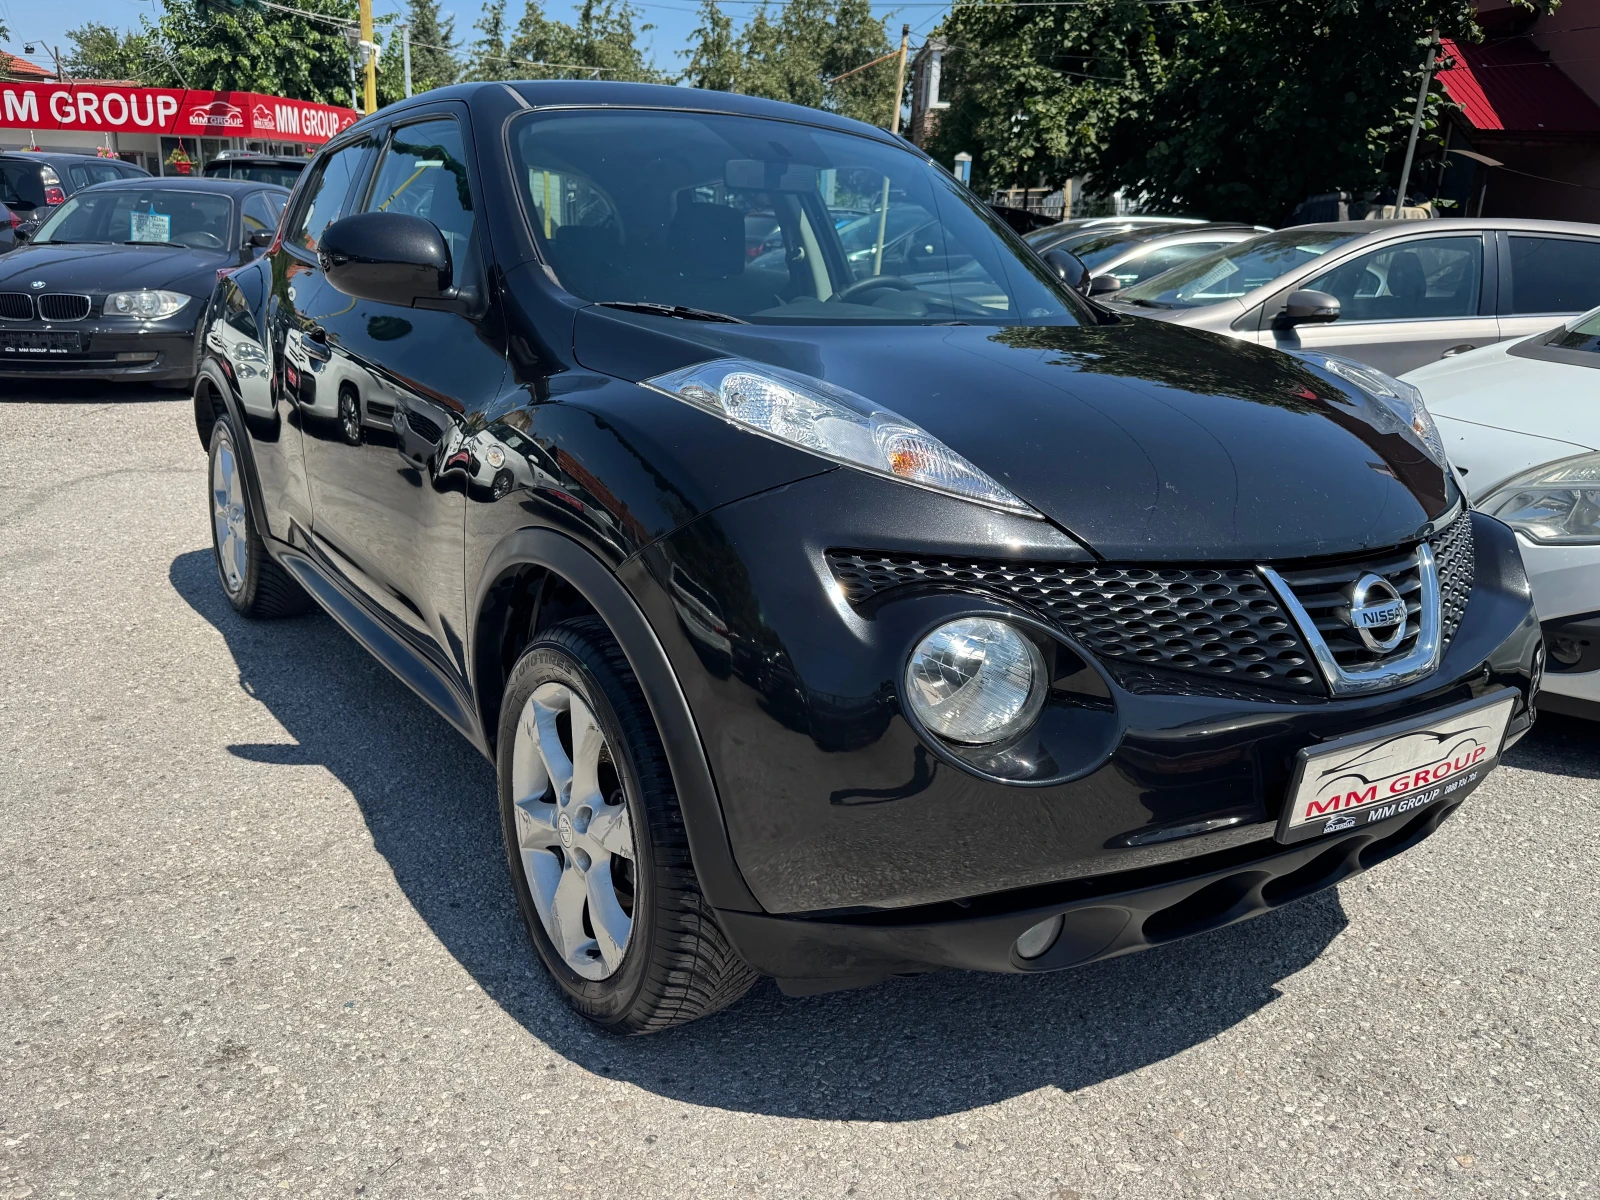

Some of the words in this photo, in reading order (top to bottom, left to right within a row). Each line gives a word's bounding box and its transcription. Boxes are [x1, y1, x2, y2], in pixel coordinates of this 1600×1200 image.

[0, 90, 39, 122] M
[50, 91, 178, 127] GROUP
[189, 116, 208, 124] MM
[210, 117, 243, 125] GROUP
[275, 104, 300, 134] MM
[301, 108, 339, 138] GROUP
[1363, 605, 1407, 624] NISSAN
[1305, 786, 1377, 817] MM
[1389, 746, 1486, 794] GROUP
[1368, 805, 1396, 822] MM
[1398, 789, 1440, 813] GROUP
